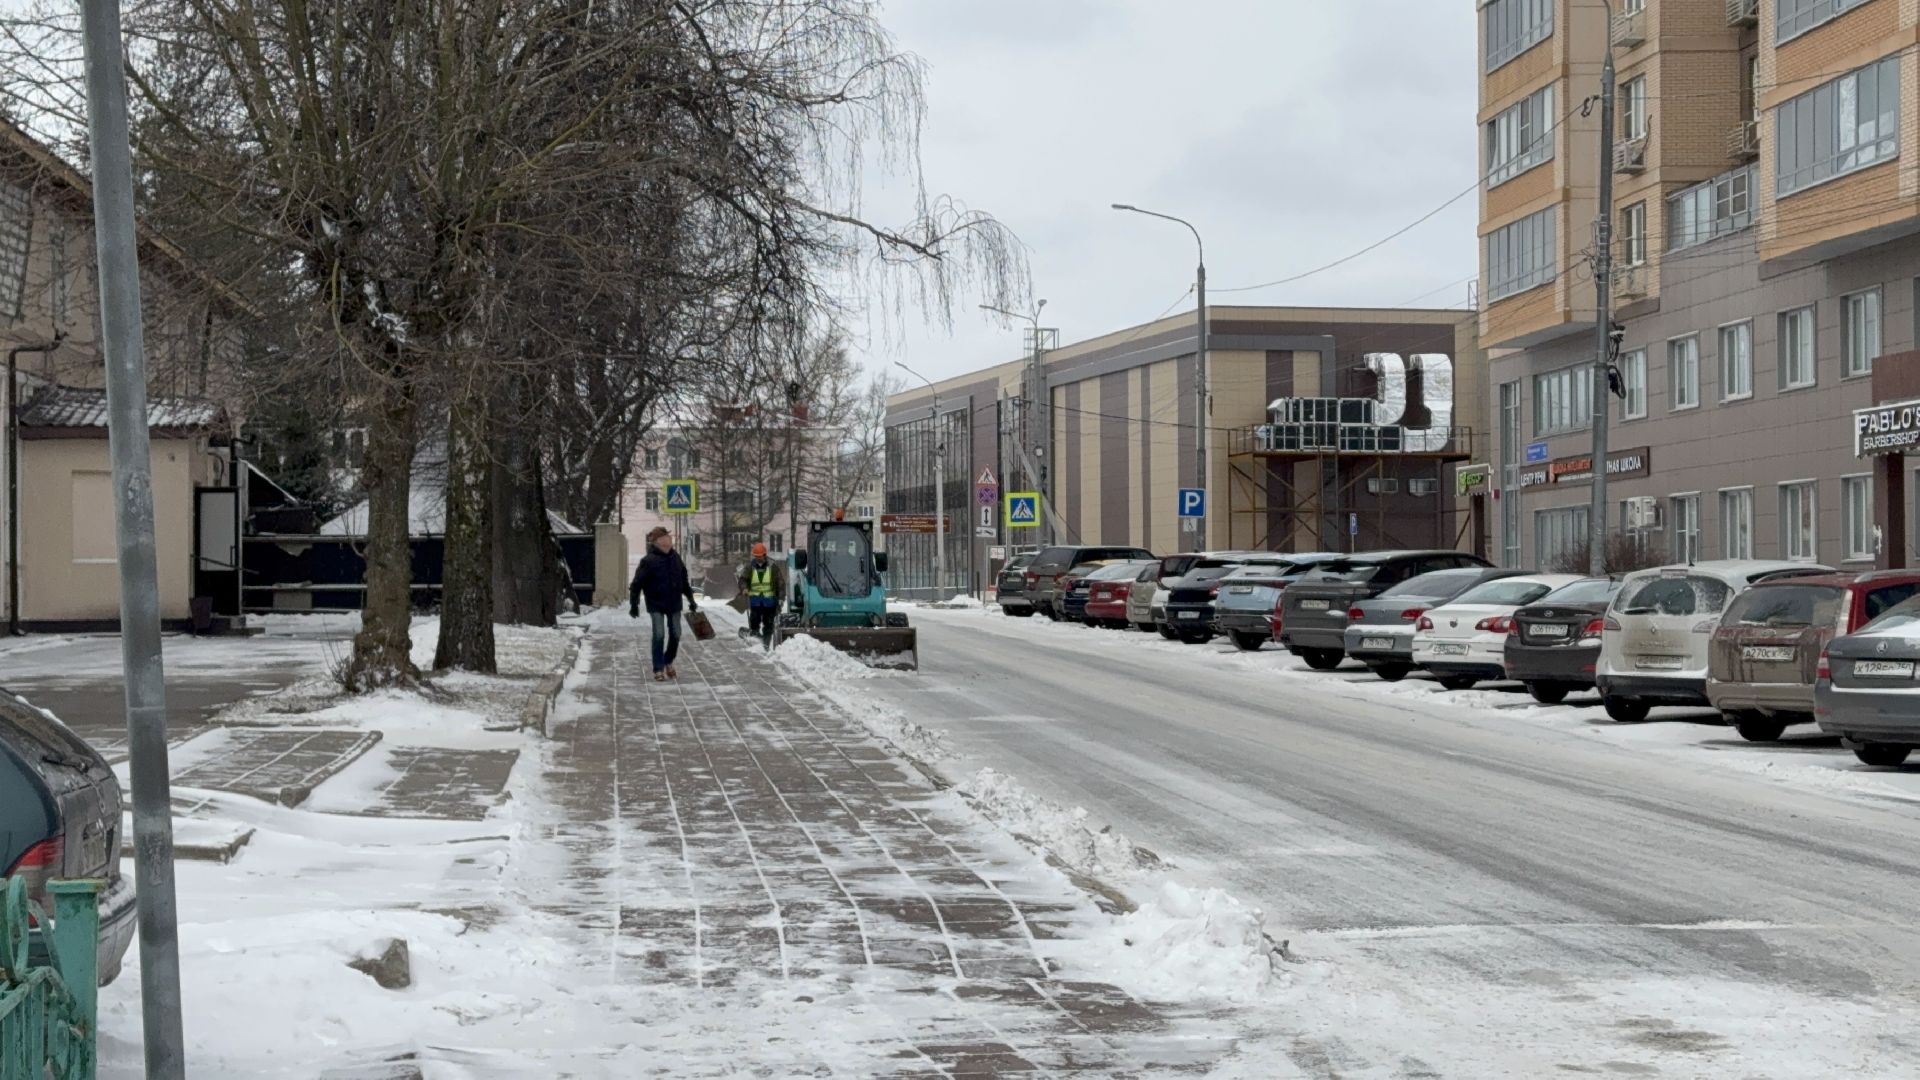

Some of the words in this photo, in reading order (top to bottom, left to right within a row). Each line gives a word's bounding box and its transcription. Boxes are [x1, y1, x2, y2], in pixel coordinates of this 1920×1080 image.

[1863, 431, 1919, 450] BARBERSHOP
[1620, 455, 1641, 472] ШКОЛА
[1185, 492, 1201, 514] P
